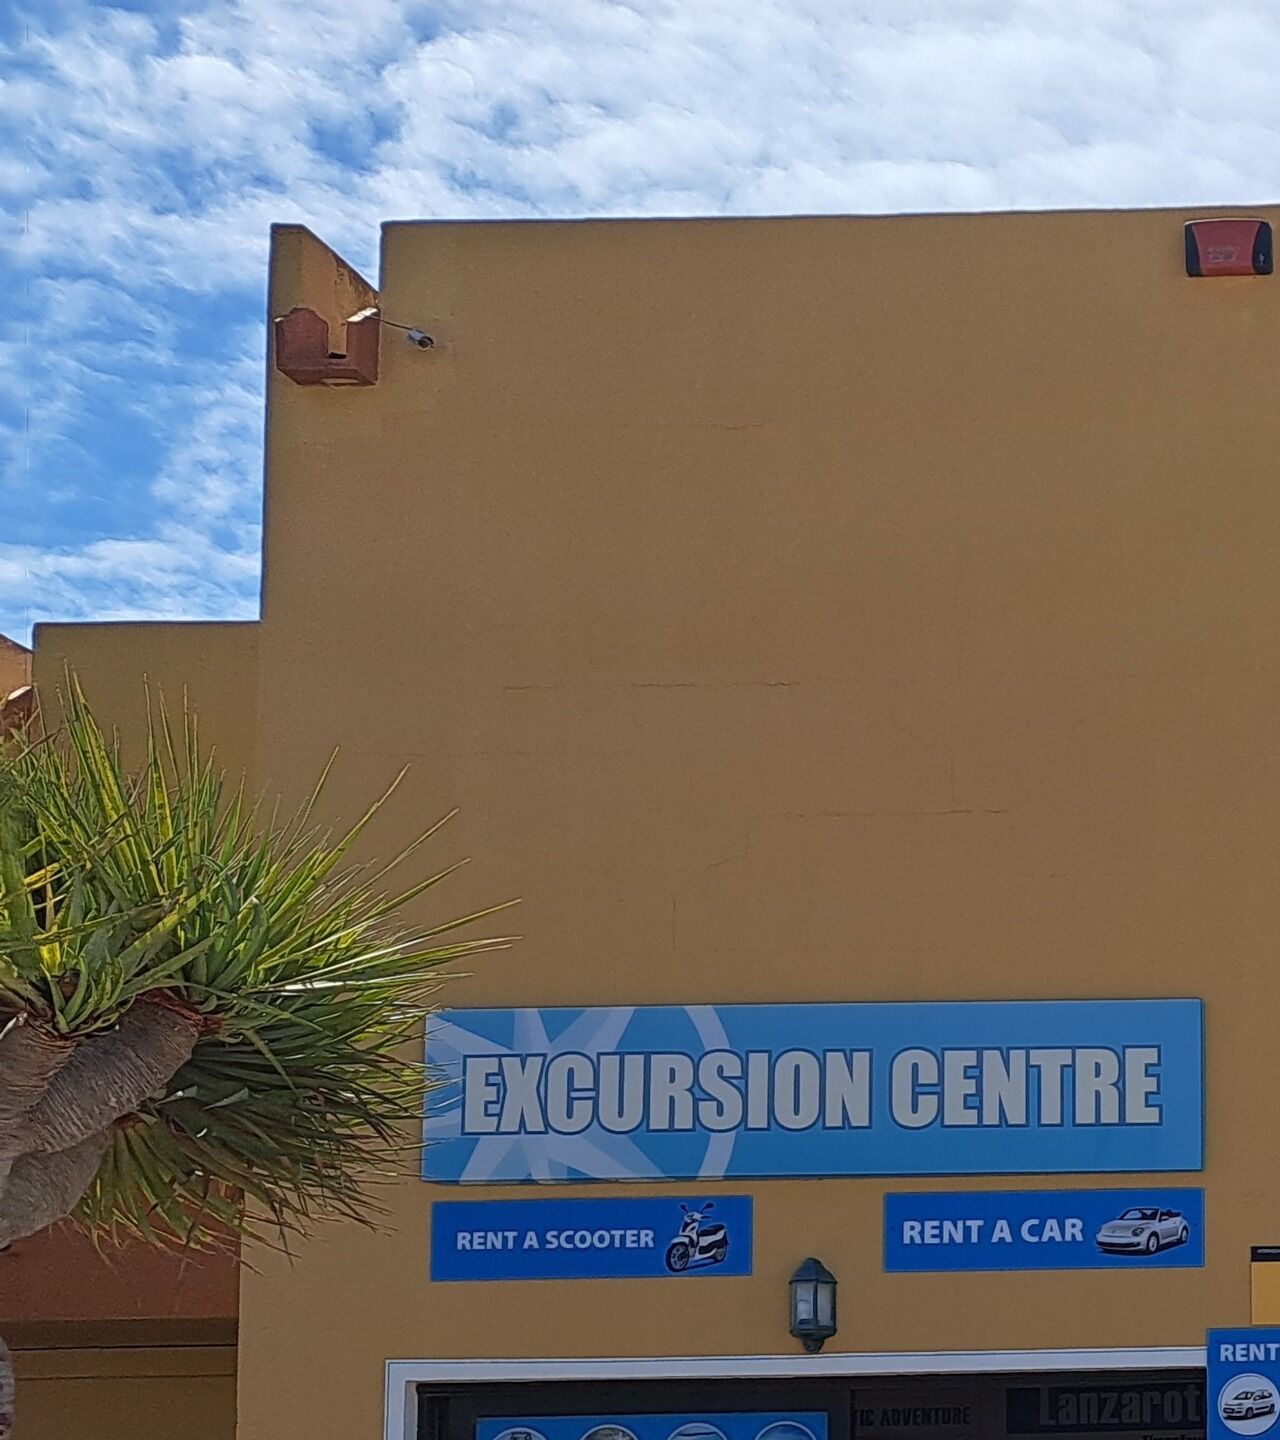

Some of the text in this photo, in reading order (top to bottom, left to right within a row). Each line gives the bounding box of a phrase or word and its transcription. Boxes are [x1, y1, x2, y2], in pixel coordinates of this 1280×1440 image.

[461, 1044, 1163, 1136] EXCURSION CENTRE
[456, 1229, 654, 1250] RENT A SCOOTER
[902, 1214, 1084, 1248] RENT A CAR
[1219, 1343, 1280, 1361] RENT
[880, 1407, 971, 1426] ADVENTURE
